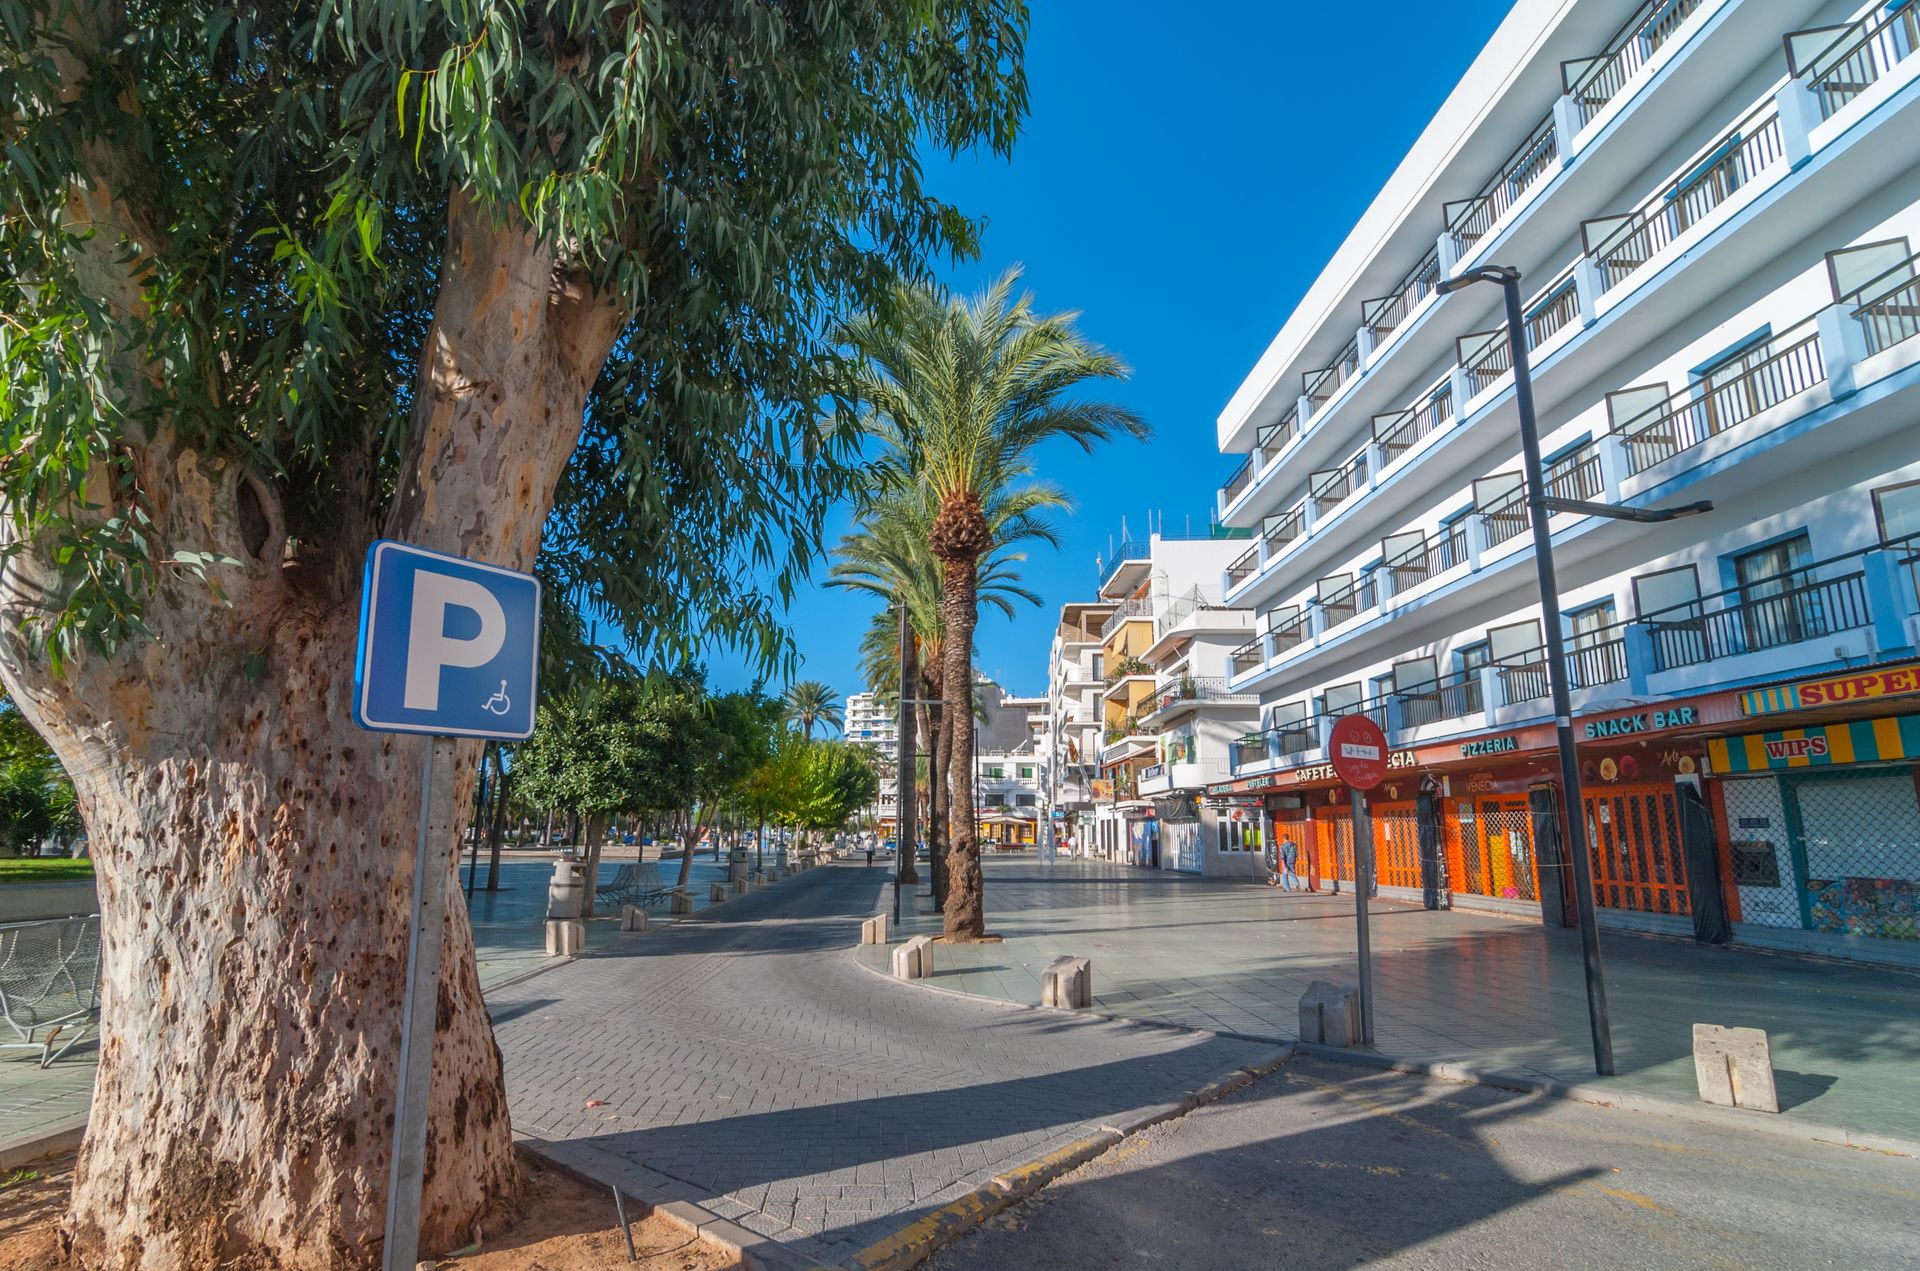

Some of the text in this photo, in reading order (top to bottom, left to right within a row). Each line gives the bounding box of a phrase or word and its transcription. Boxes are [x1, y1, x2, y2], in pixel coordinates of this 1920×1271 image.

[403, 568, 507, 711] P
[1584, 706, 1693, 738] SNACK BAR
[1460, 736, 1515, 756] PIZZERIA
[1765, 736, 1828, 759] WIPS
[1295, 764, 1338, 782] CAFETE
